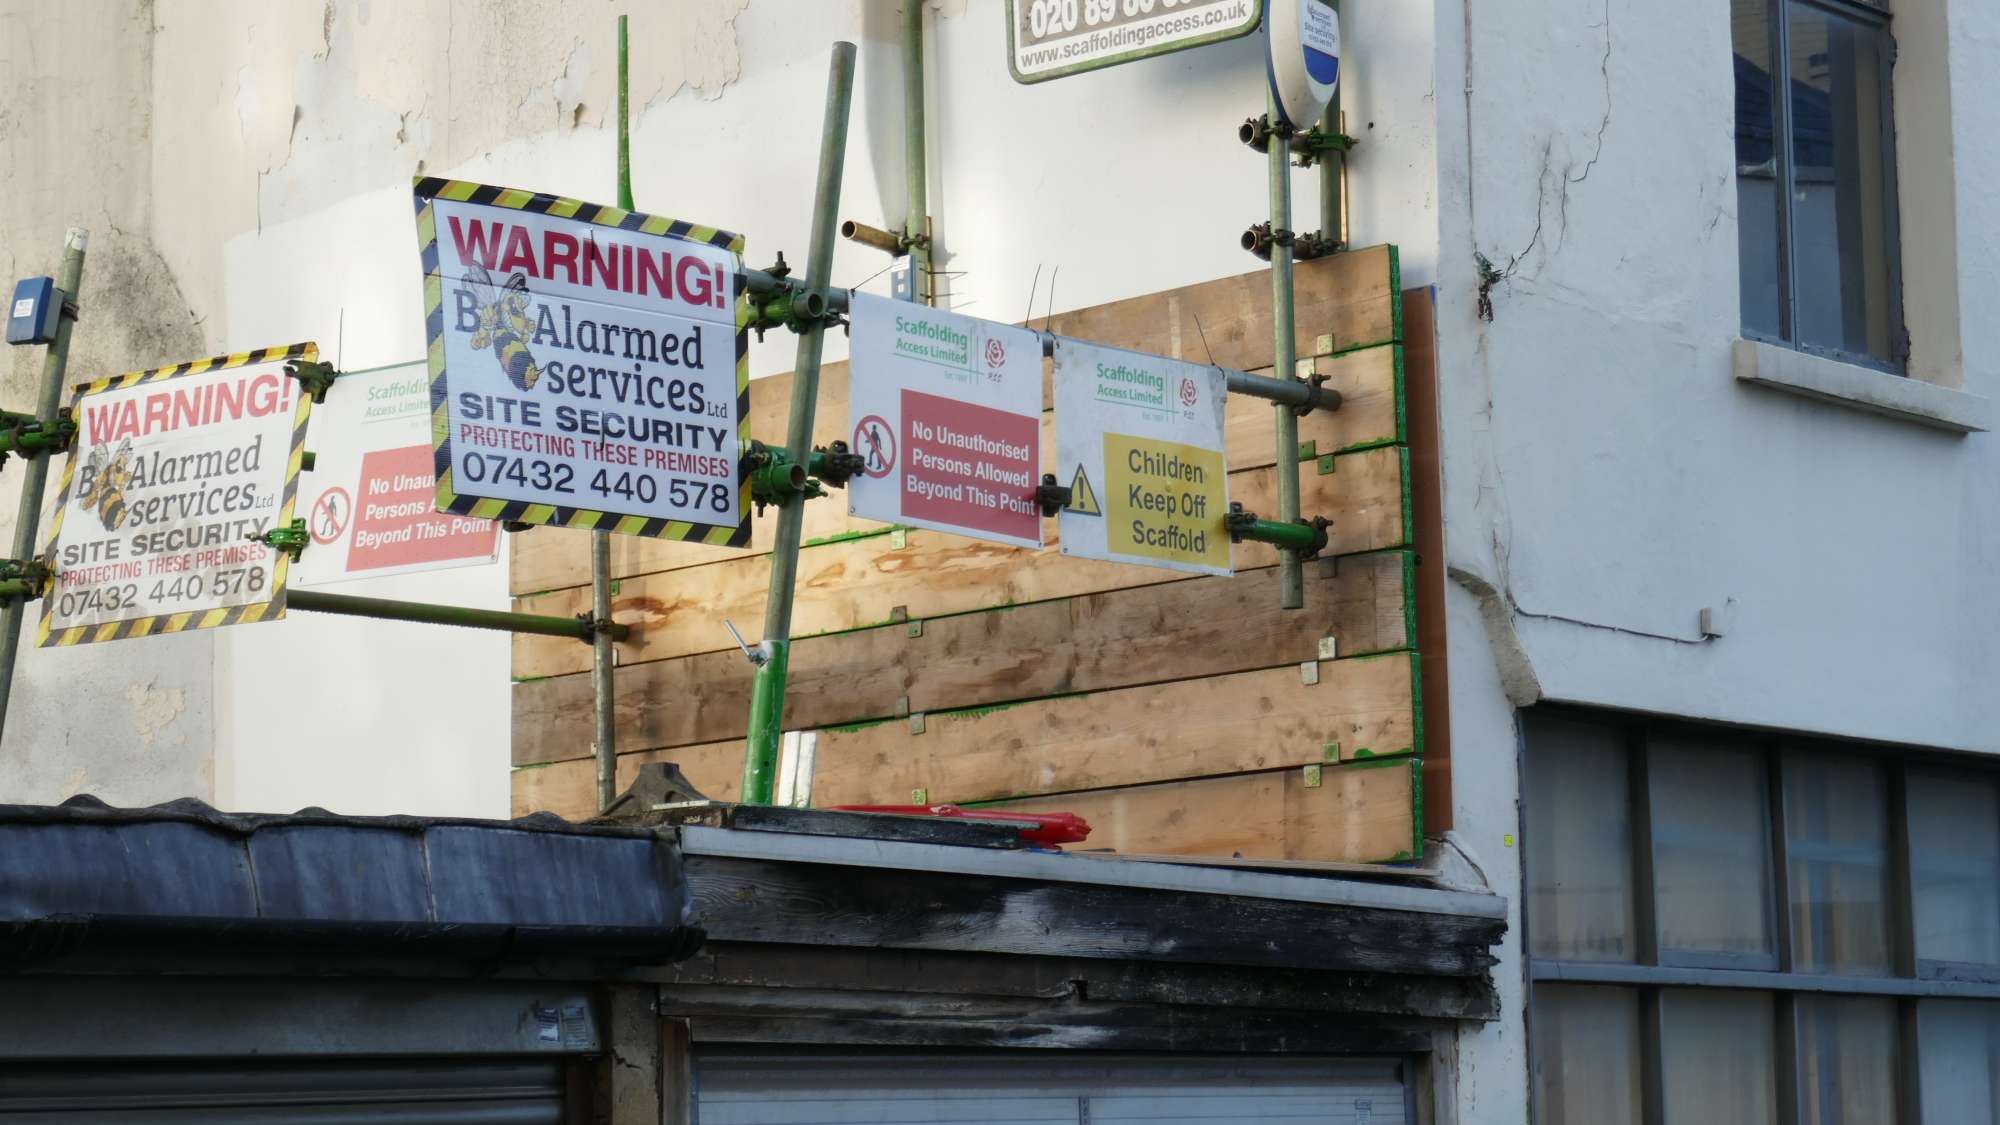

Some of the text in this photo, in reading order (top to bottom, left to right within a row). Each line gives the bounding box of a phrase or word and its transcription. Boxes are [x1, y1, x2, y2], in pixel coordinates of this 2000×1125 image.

[1021, 2, 1247, 67] www.scaffoldingaccess.co.uk
[1031, 0, 1078, 38] 020
[447, 216, 726, 309] WARNING!
[532, 304, 704, 370] Alarmed
[896, 316, 968, 350] Scaffolding
[896, 338, 968, 364] Access Limited
[368, 378, 430, 401] Scaffoldin
[547, 361, 728, 419] services Ltd
[1096, 363, 1163, 392] Scaffolding
[1097, 383, 1163, 405] Access Limited
[88, 374, 291, 446] WARNING!
[364, 399, 430, 418] Access Limite
[459, 392, 728, 452] SITE SECURITY
[460, 424, 729, 478] PROTECTING THESE PREMISES
[912, 420, 1029, 461] No Unauthorised
[126, 434, 262, 490] Alarmed
[463, 452, 730, 513] 07432 440 578
[912, 448, 1029, 488] Persons Allowed
[1128, 448, 1203, 484] Children
[130, 481, 274, 527] services Ltd
[368, 475, 435, 495] No Unaut
[907, 474, 1035, 515] Beyond This Point
[1128, 484, 1206, 519] Keep Off
[365, 501, 425, 520] Persons
[63, 517, 270, 566] SITE SECURITY
[355, 518, 492, 549] Beyond This Point
[1132, 520, 1206, 553] Scaffold
[61, 544, 268, 588] PROTECTING THESE PREMISES
[60, 566, 265, 617] 07432 440 578
